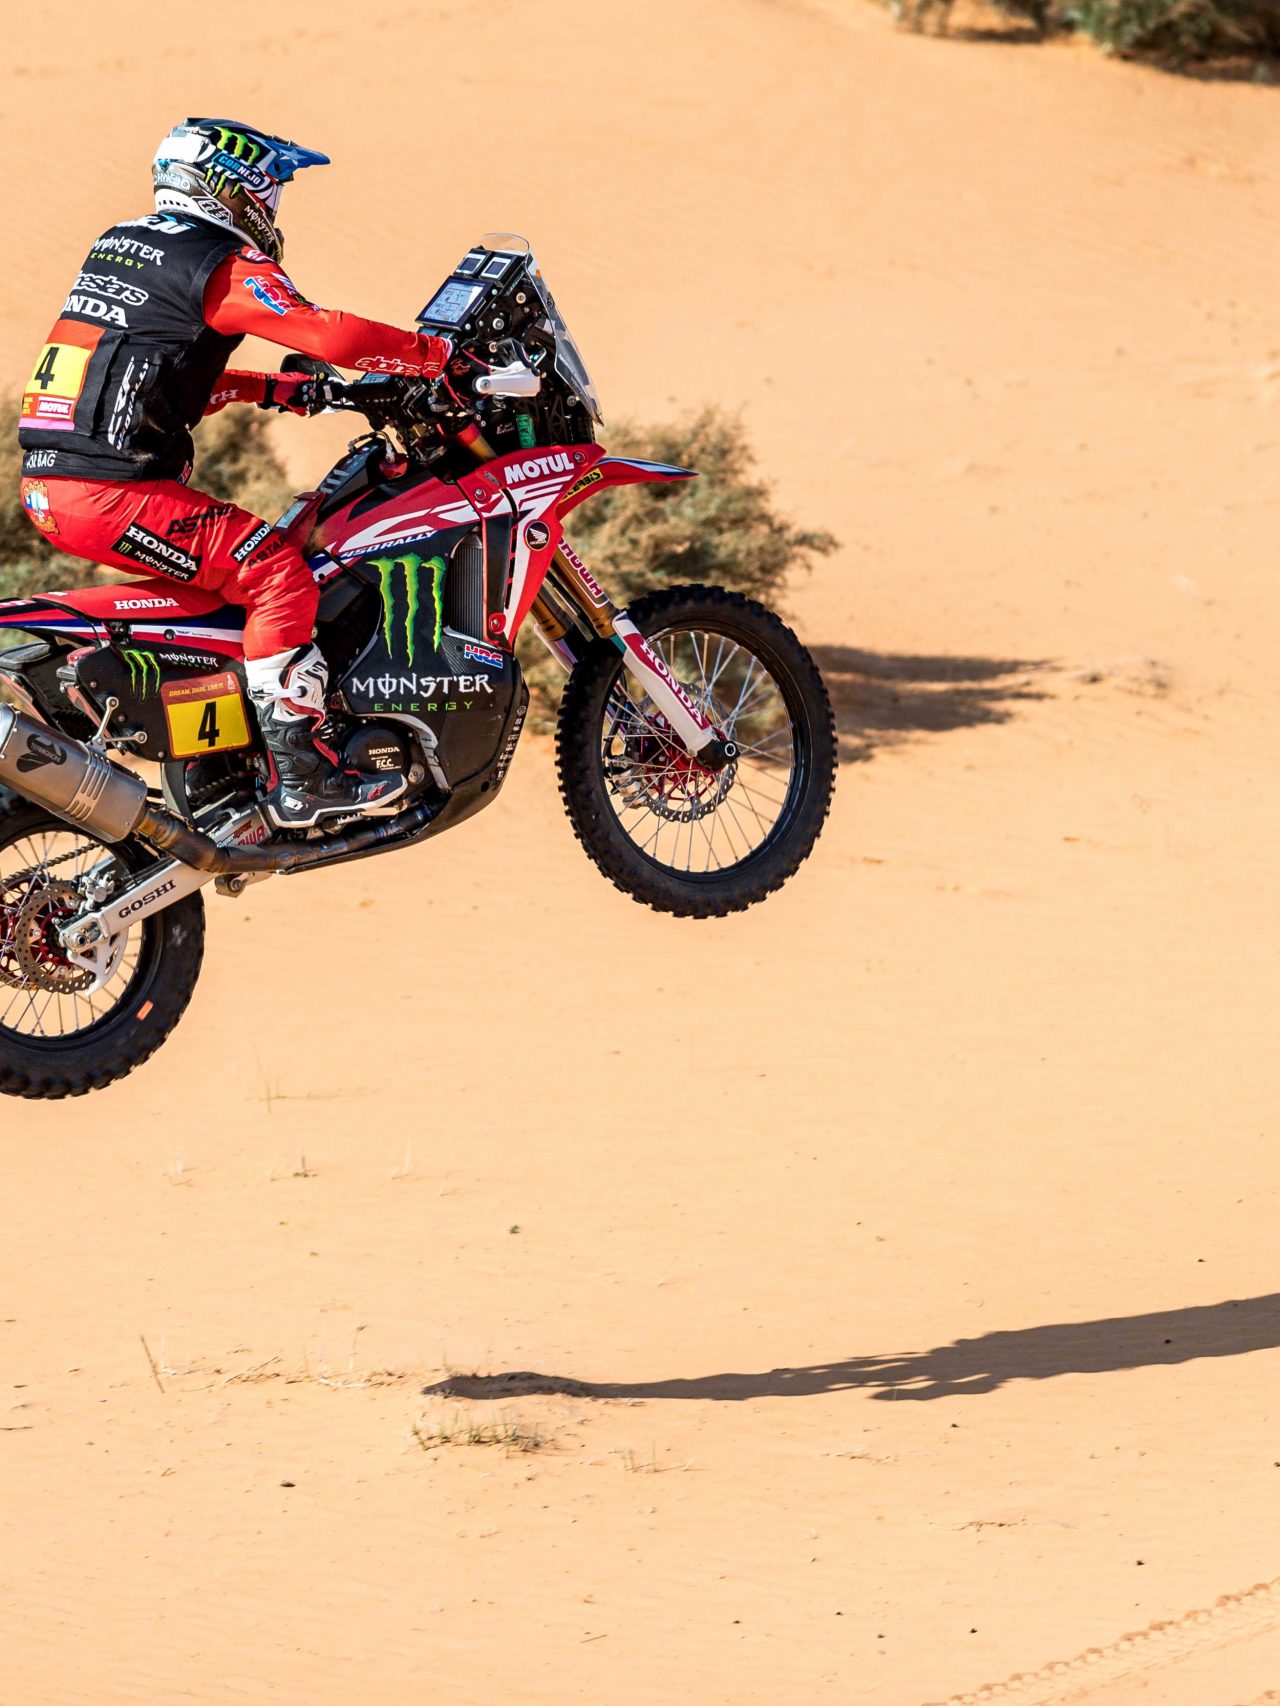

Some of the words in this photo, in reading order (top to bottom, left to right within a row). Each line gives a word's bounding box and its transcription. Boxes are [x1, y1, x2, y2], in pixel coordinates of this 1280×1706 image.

[219, 155, 261, 185] CORNEJO
[244, 204, 276, 245] MONSTER
[90, 252, 144, 269] ENERGY
[94, 236, 165, 266] MONSTER
[61, 295, 129, 328] NDA
[34, 346, 60, 390] 4
[38, 401, 70, 414] MOTUL
[504, 453, 575, 485] MOTUL
[125, 525, 198, 572] HONDA
[233, 523, 273, 562] HONDA
[340, 530, 438, 558] 450RALLY
[135, 550, 189, 581] MONSTER
[113, 597, 180, 611] HONDA
[159, 652, 219, 668] MONSTER
[464, 644, 504, 669] HRC
[351, 672, 494, 699] MONSTER
[640, 639, 703, 727] HONDA
[374, 701, 473, 712] ENERGY
[197, 701, 220, 748] 4
[368, 746, 401, 756] HONDA
[118, 879, 177, 919] GOSHI
